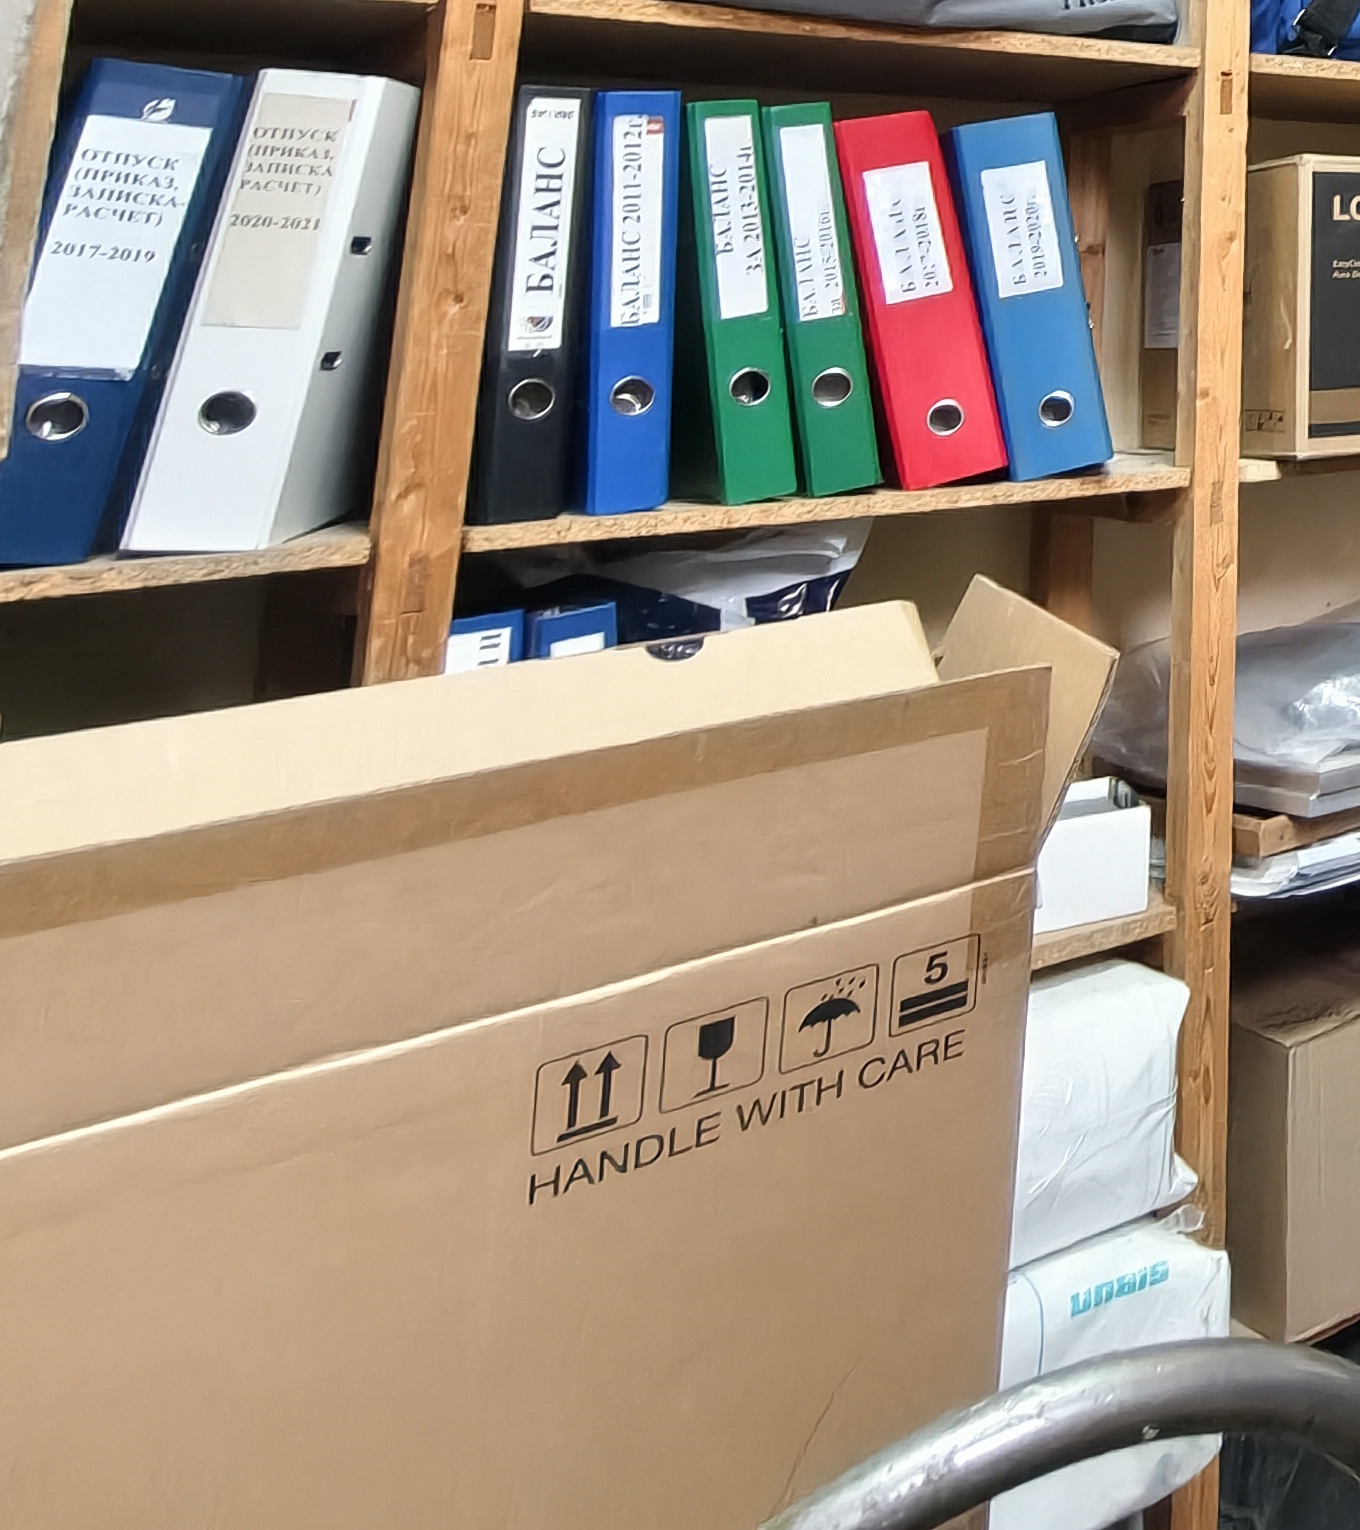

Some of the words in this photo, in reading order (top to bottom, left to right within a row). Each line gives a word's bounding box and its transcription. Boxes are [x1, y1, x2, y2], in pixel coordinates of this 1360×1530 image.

[81, 147, 180, 171] ОТПУСК
[252, 126, 341, 143] ОТПУСК
[61, 202, 163, 227] РАСЧЕТ)
[525, 146, 566, 295] БАЛАНС
[709, 164, 734, 256] БАЛАНС
[50, 240, 157, 264] 2017-2019
[745, 246, 763, 276] ЗА
[1000, 194, 1027, 285] БАЛАНС
[620, 229, 642, 326] БАЛАНС
[794, 237, 819, 319] БАЛАНС
[924, 950, 949, 985] 5
[528, 1111, 722, 1205] HANDLE
[736, 1070, 845, 1133] WITH
[858, 1029, 966, 1090] CARE
